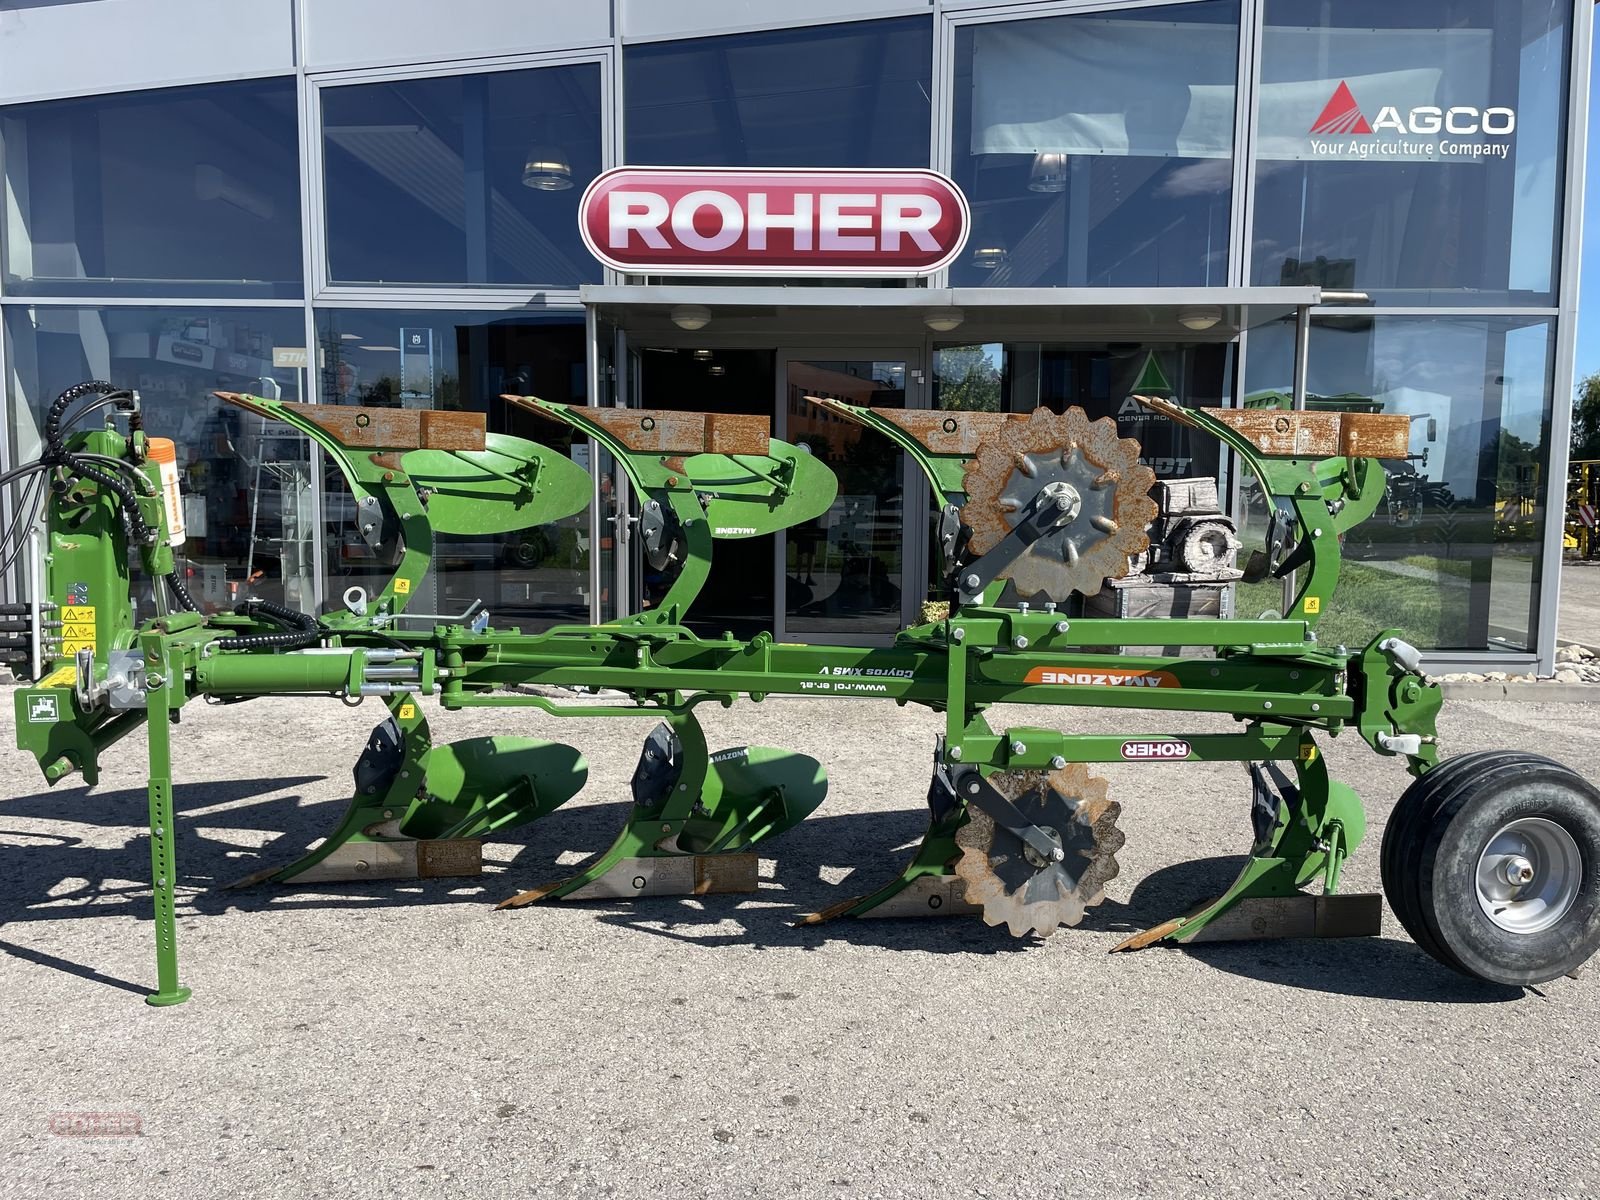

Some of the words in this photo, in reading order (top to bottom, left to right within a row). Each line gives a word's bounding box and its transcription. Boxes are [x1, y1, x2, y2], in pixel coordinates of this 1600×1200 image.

[1371, 106, 1515, 135] AGCO
[1310, 140, 1344, 154] Your
[1349, 140, 1433, 159] Agriculture
[1439, 141, 1510, 159] Company
[608, 190, 944, 252] ROHER
[277, 352, 307, 362] STIH
[714, 527, 757, 535] AMAZONE
[819, 666, 829, 675] V
[833, 666, 863, 676] XMS
[866, 668, 914, 678] Cayros
[1041, 672, 1162, 687] AMAZONE
[1125, 743, 1187, 756] ROHER
